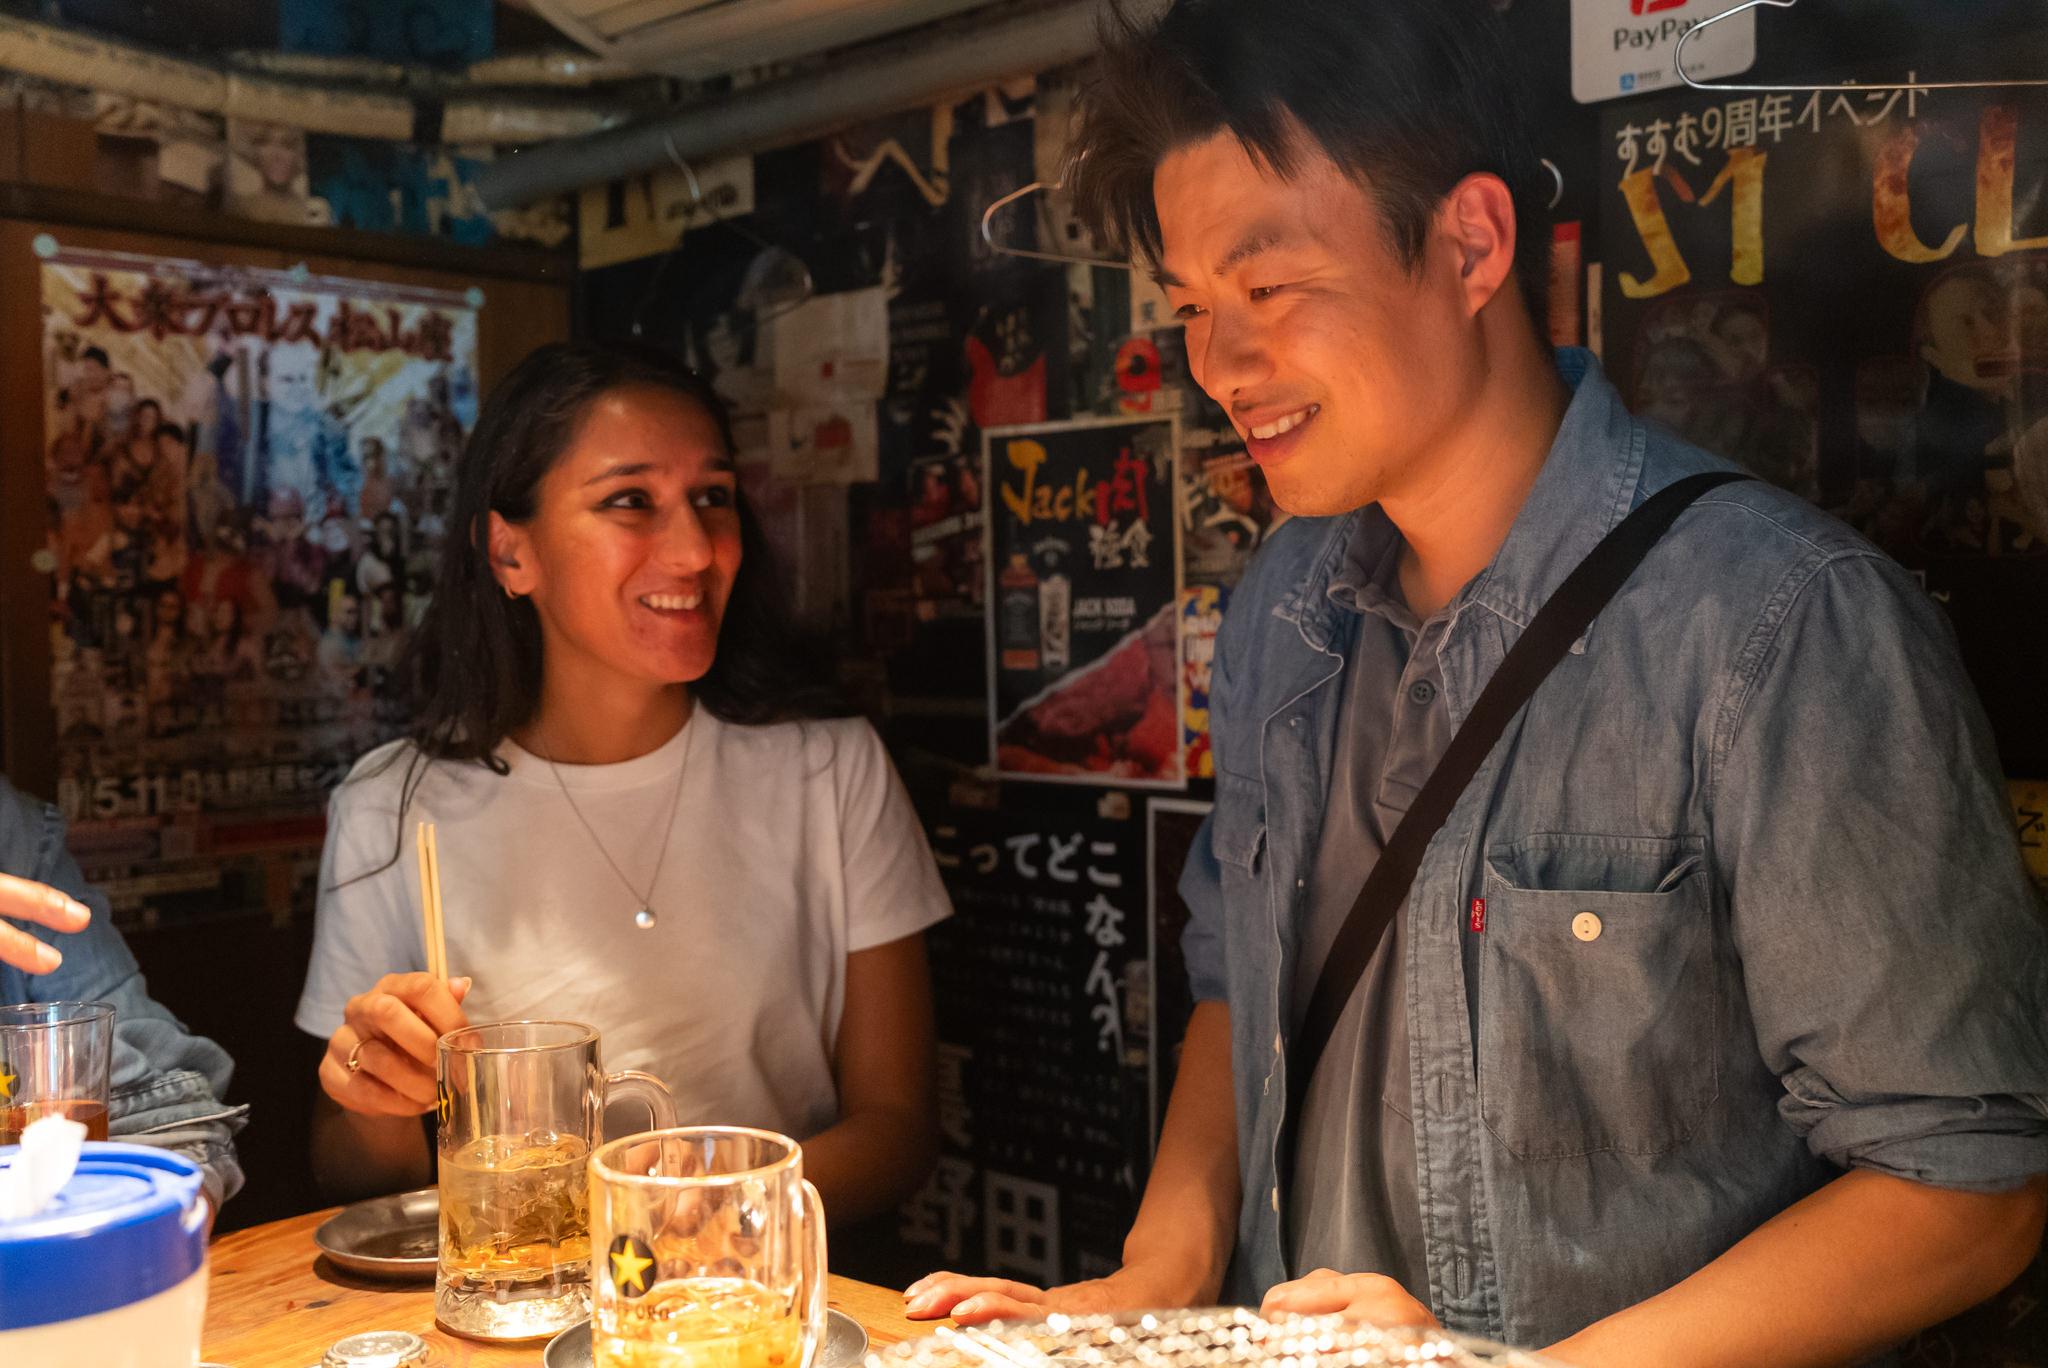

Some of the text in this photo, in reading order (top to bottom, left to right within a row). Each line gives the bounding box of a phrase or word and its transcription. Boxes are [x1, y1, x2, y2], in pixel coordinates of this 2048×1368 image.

[1613, 16, 1710, 51] PayPay
[1616, 71, 1928, 179] すすむ9周年イベント
[1001, 439, 1096, 526] Jack
